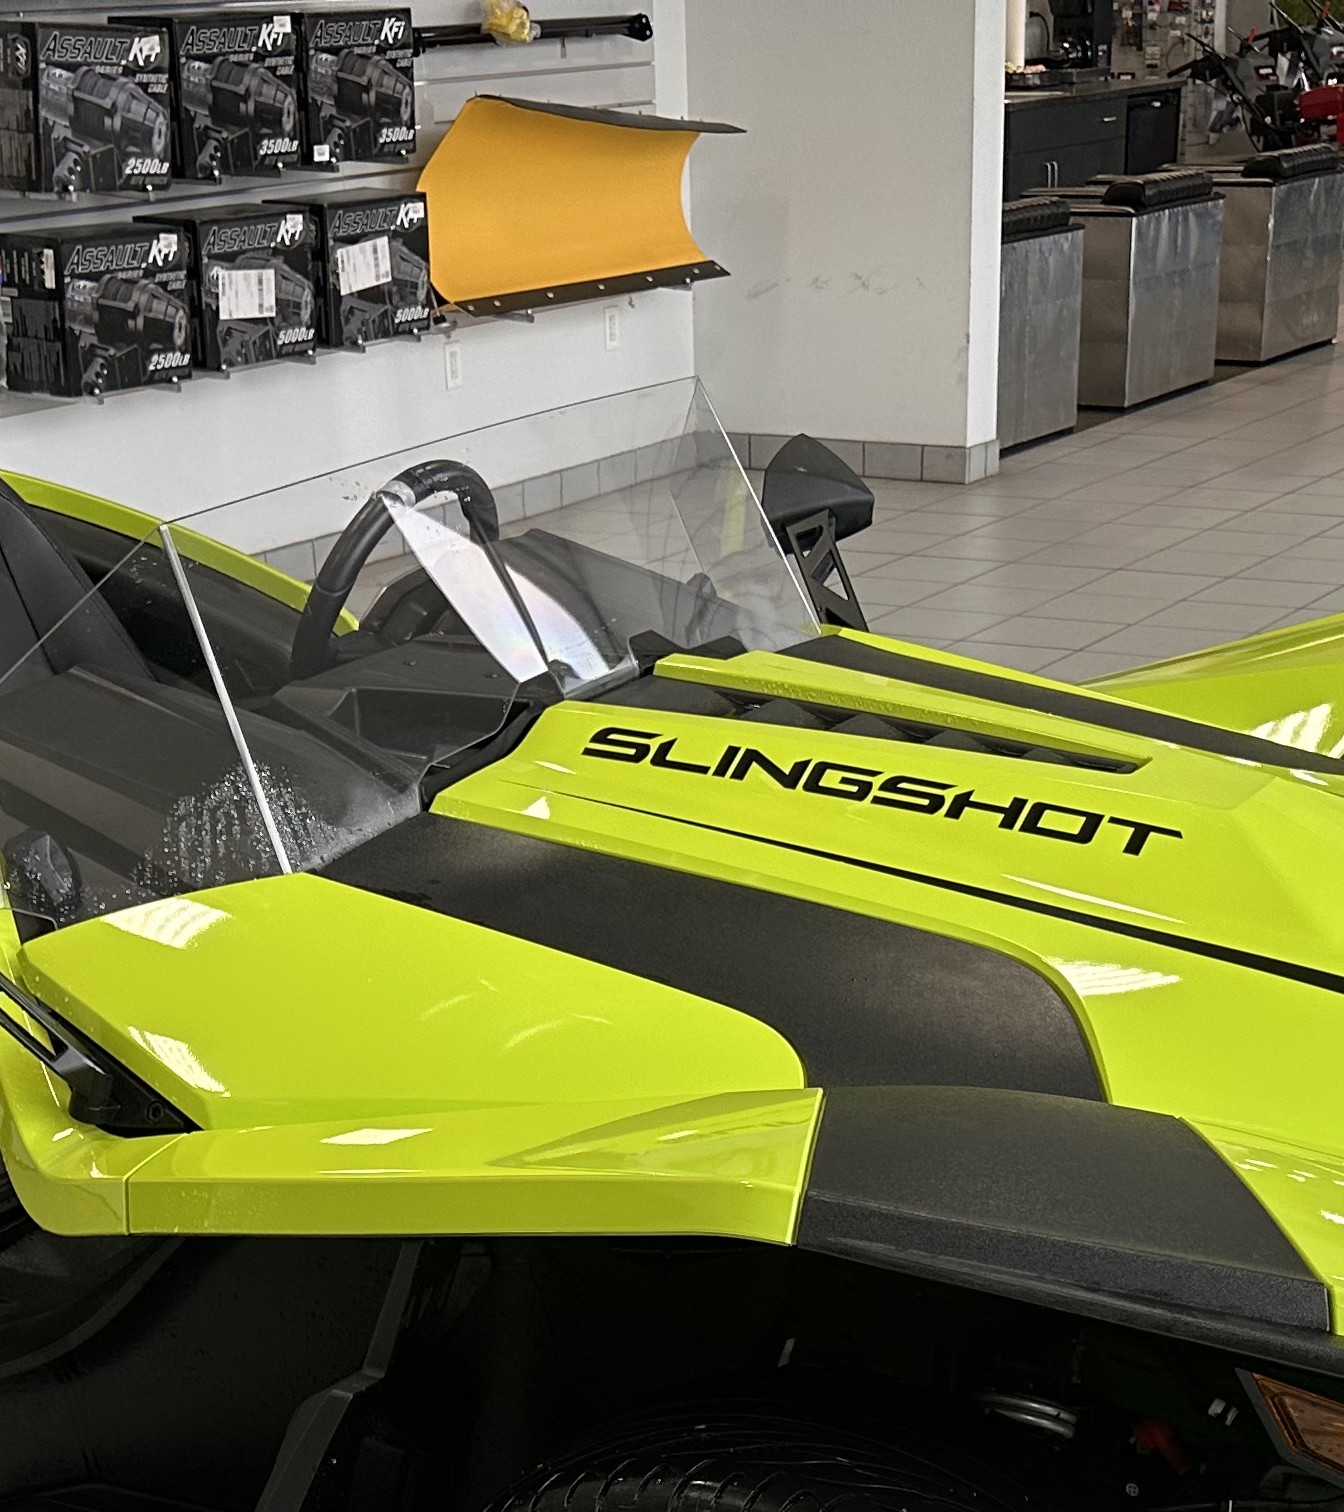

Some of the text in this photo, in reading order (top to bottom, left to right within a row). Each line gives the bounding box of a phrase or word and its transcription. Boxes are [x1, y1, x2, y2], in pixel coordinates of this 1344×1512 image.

[39, 30, 131, 63] ASSAULT
[179, 25, 258, 56] ASSAULT
[309, 19, 382, 48] ASSAULT
[328, 206, 398, 238] ASSAULT
[204, 224, 279, 254] ASSAULT
[63, 242, 150, 276] ASSAULT
[580, 725, 1184, 857] SLINGSHOT
